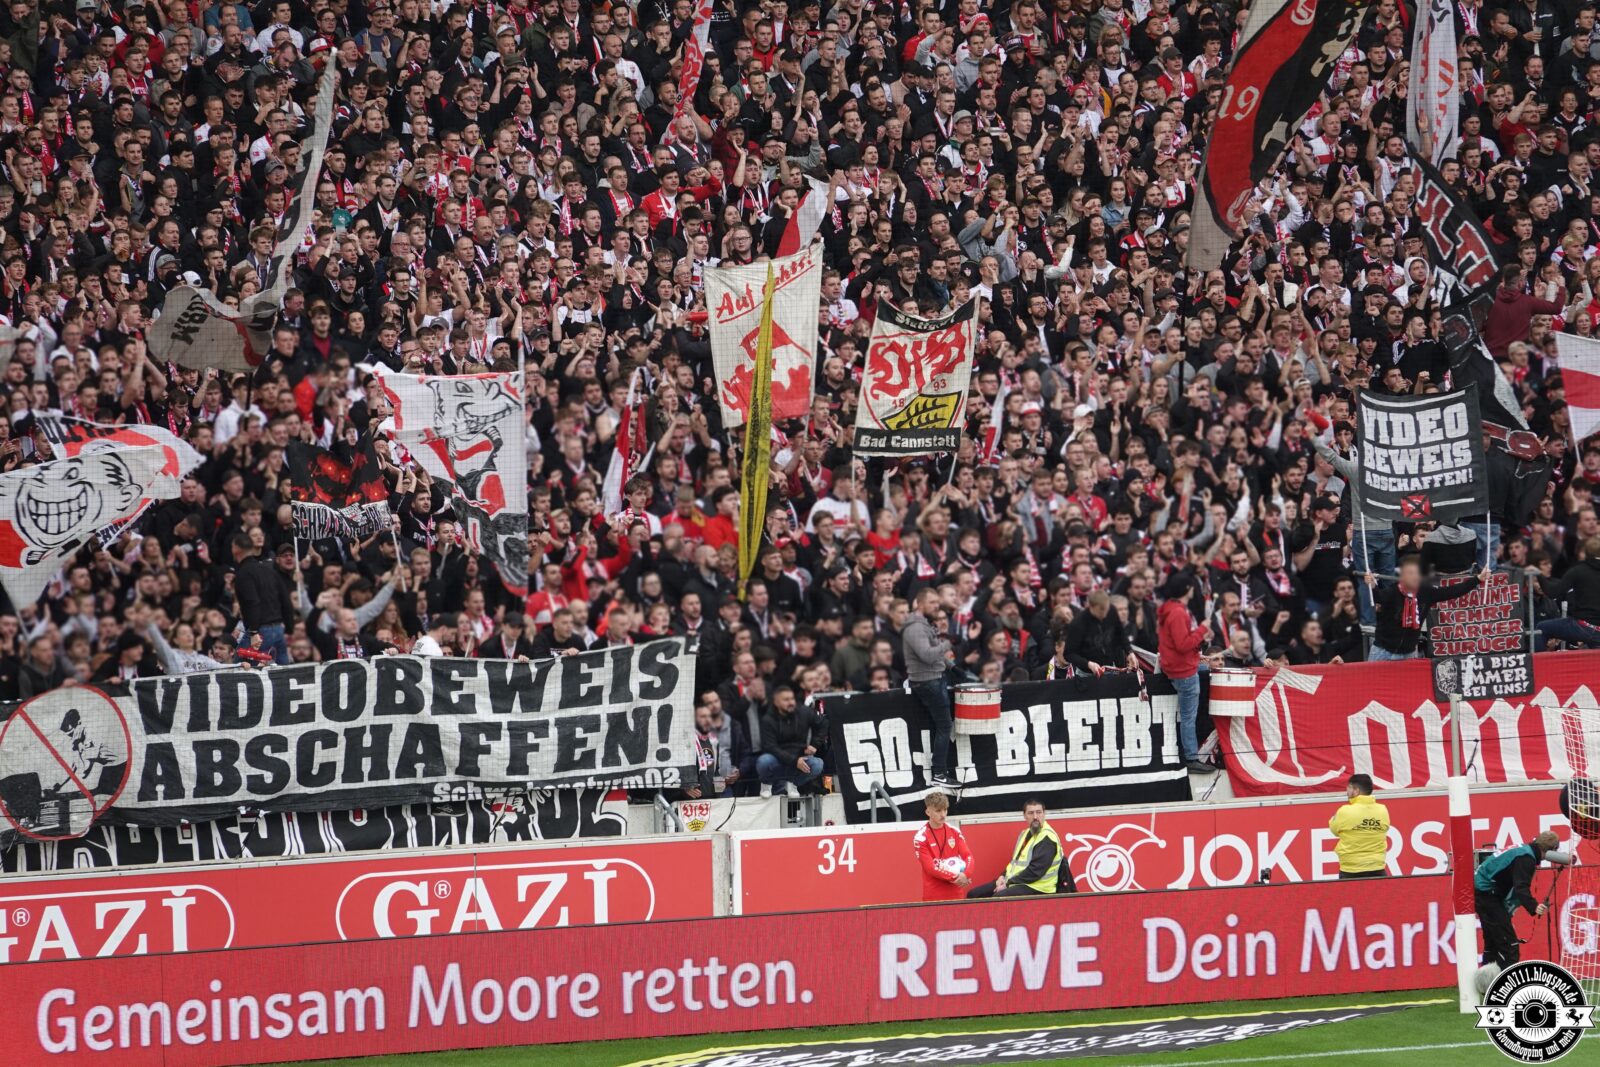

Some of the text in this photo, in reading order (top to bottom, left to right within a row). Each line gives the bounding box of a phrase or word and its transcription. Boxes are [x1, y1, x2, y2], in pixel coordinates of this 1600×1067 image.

[933, 379, 947, 392] 93
[859, 434, 956, 448] Bad Cannstatt
[1361, 402, 1469, 446] VIDEO
[1363, 439, 1472, 475] BEWEIS
[1365, 468, 1474, 492] ABSCHAFFEN!
[1439, 604, 1514, 625] KEHRT
[1491, 654, 1526, 669] BIST
[135, 640, 680, 735] VIDEOBEWEIS
[1462, 682, 1530, 697] BEI UNS!
[140, 707, 672, 801] ABSCHAFFEN!
[996, 695, 1182, 778] BLEIBT
[817, 838, 858, 875] 34
[879, 921, 1103, 1000] REWE
[1143, 913, 1278, 983] Dein
[37, 957, 814, 1055] Gemeinsam Moore retten.
